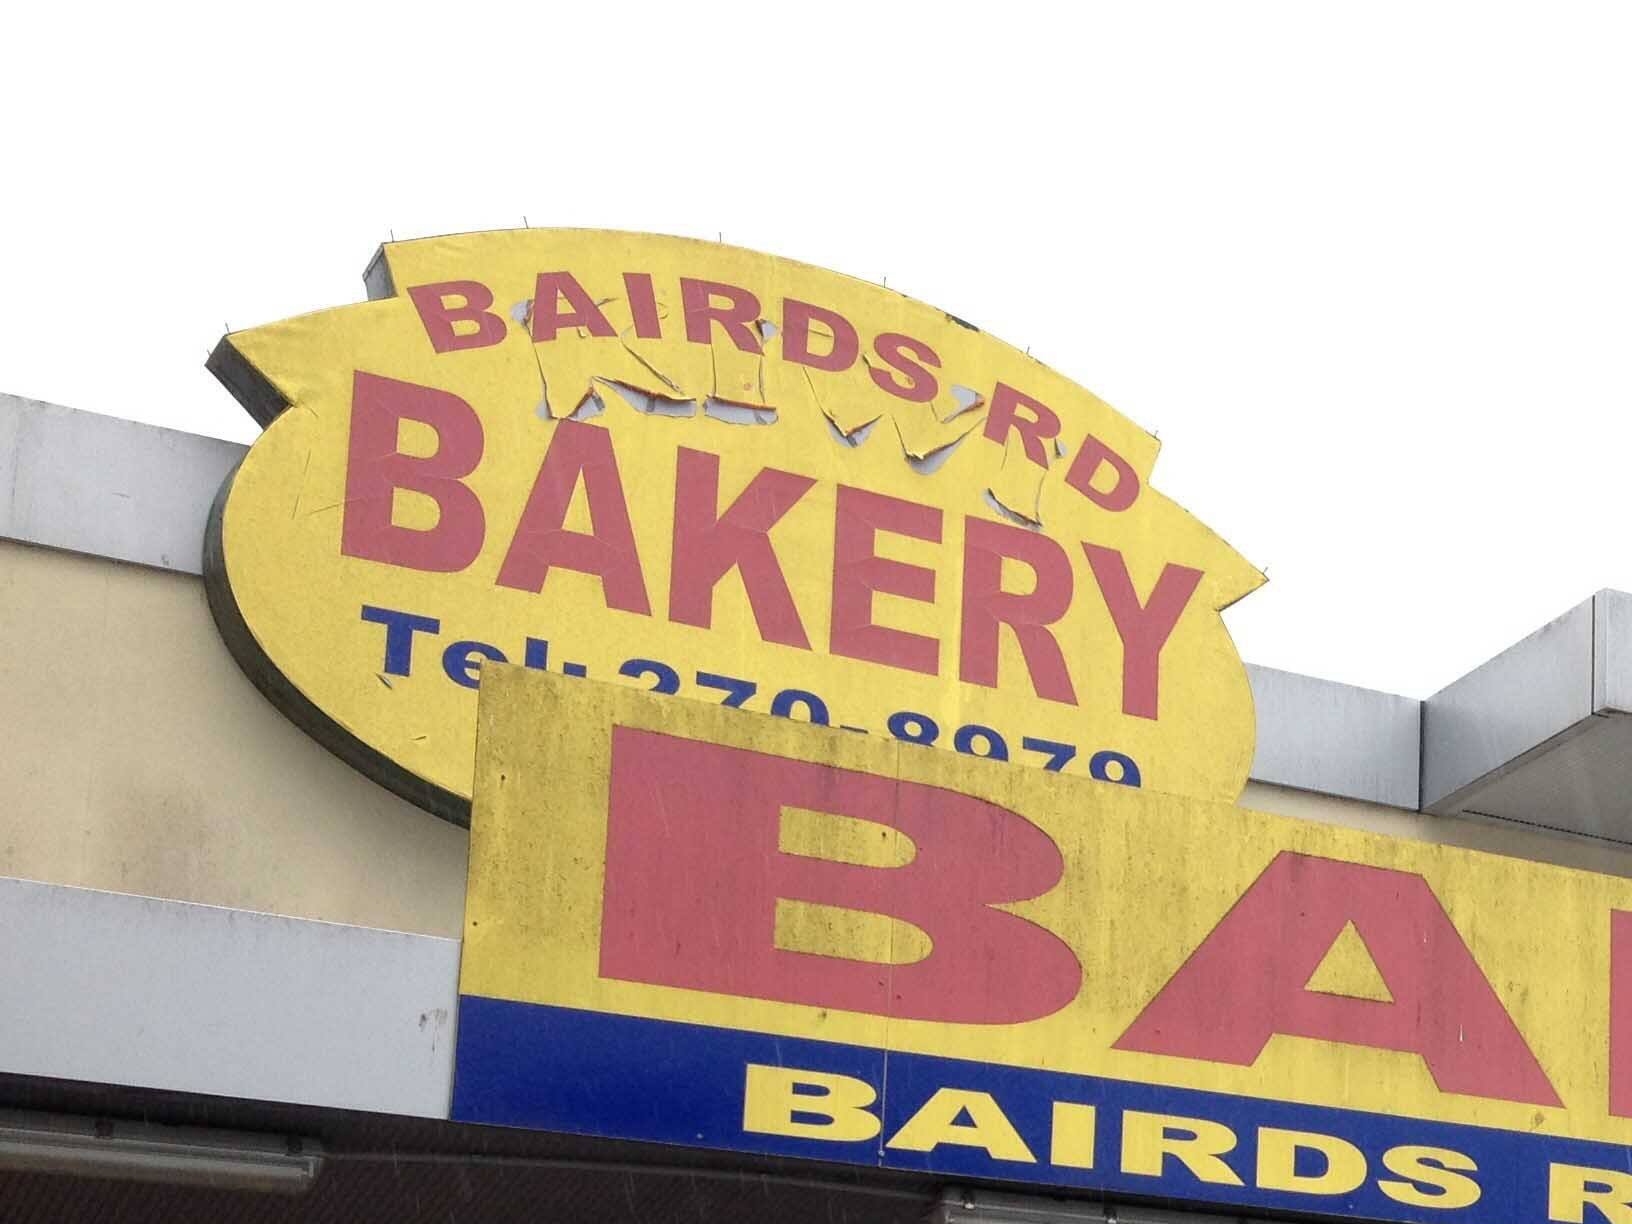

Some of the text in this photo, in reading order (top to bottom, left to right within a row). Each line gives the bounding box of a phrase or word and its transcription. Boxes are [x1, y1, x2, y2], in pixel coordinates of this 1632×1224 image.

[407, 271, 1142, 512] BAIRDS RD
[339, 368, 1206, 722] BAKERY
[741, 1062, 1482, 1210] BAIRDS
